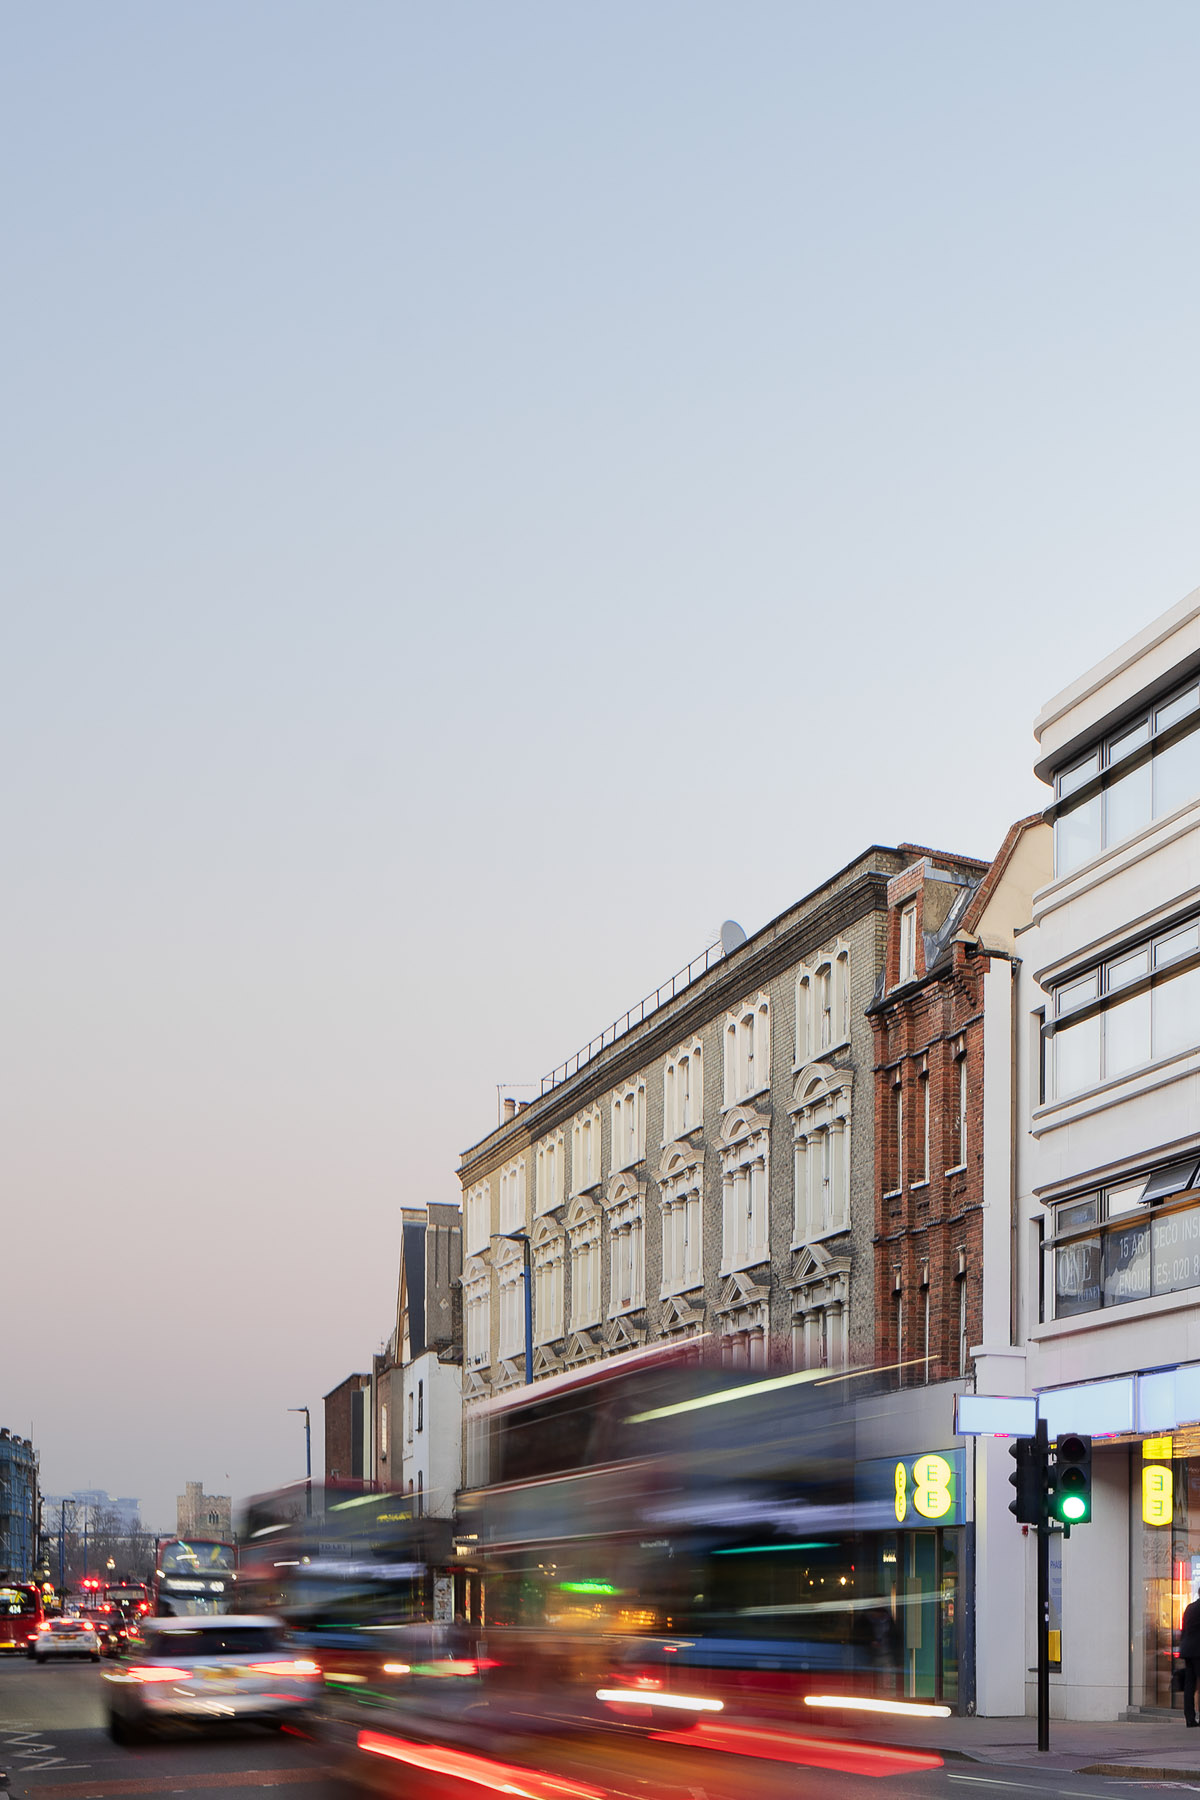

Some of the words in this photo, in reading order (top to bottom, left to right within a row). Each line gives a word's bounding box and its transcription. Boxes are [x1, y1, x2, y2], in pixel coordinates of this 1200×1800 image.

[1119, 1236, 1129, 1259] 15
[1131, 1230, 1150, 1255] ART
[1060, 1246, 1092, 1287] ONE
[1173, 1256, 1190, 1280] 020
